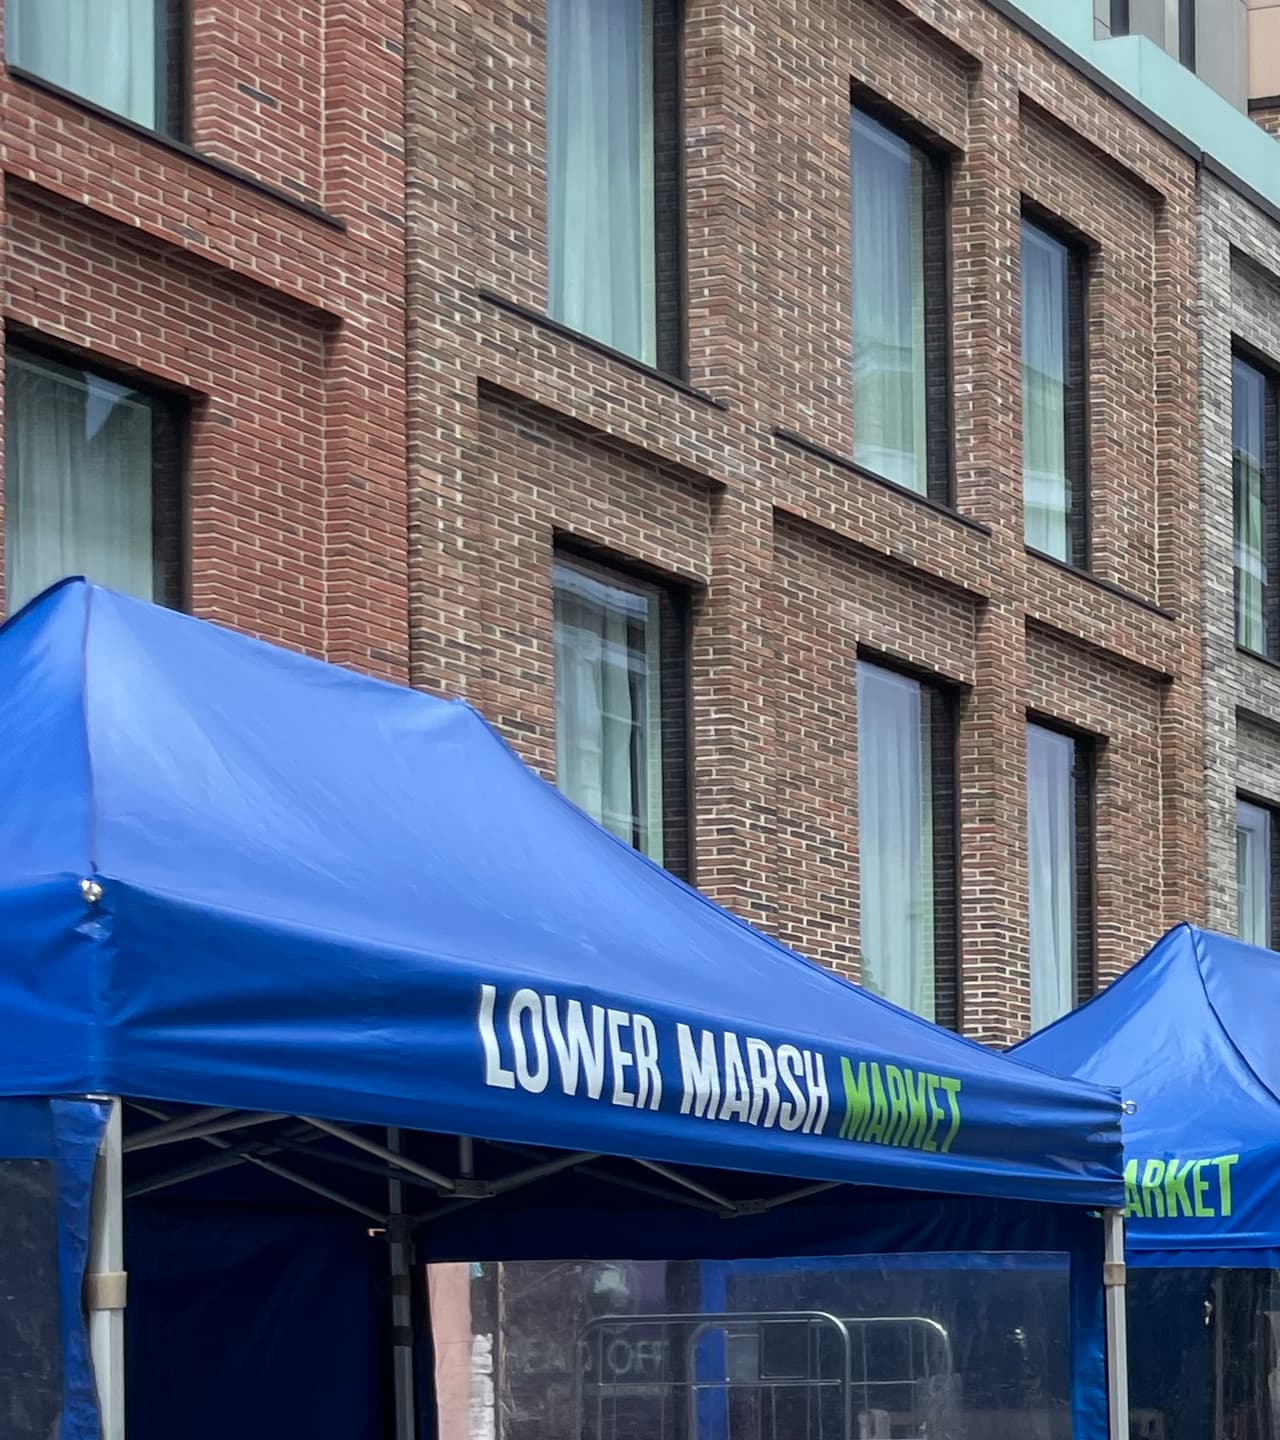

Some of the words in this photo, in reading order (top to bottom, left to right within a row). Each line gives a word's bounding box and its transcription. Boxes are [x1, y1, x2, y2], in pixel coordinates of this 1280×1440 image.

[478, 984, 661, 1112] LOWER
[676, 1022, 830, 1136] MARSH
[838, 1056, 962, 1154] MARKET
[1123, 1154, 1240, 1218] ARKET
